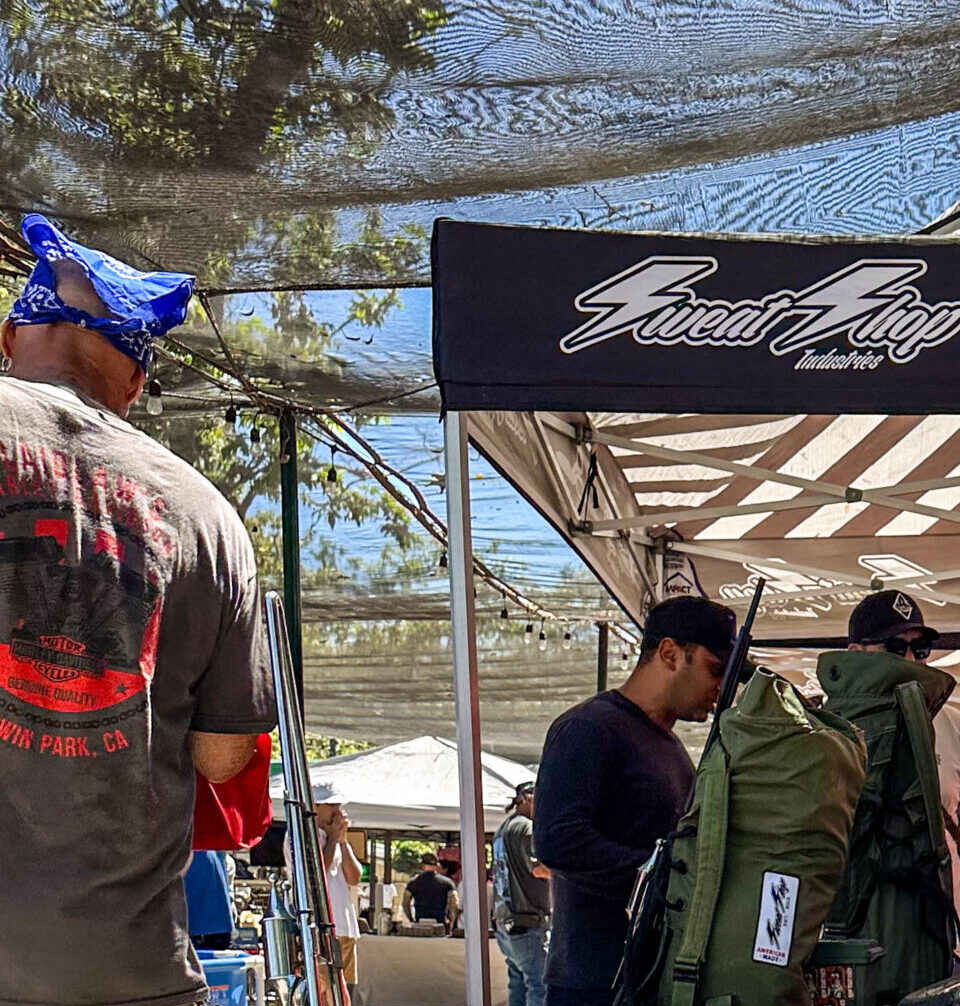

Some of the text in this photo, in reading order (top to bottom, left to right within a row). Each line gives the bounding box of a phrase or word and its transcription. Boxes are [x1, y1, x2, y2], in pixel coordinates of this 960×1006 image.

[560, 256, 797, 354] Sweat
[794, 348, 886, 371] Industries
[53, 687, 97, 707] QUALITY
[102, 729, 129, 753] CA
